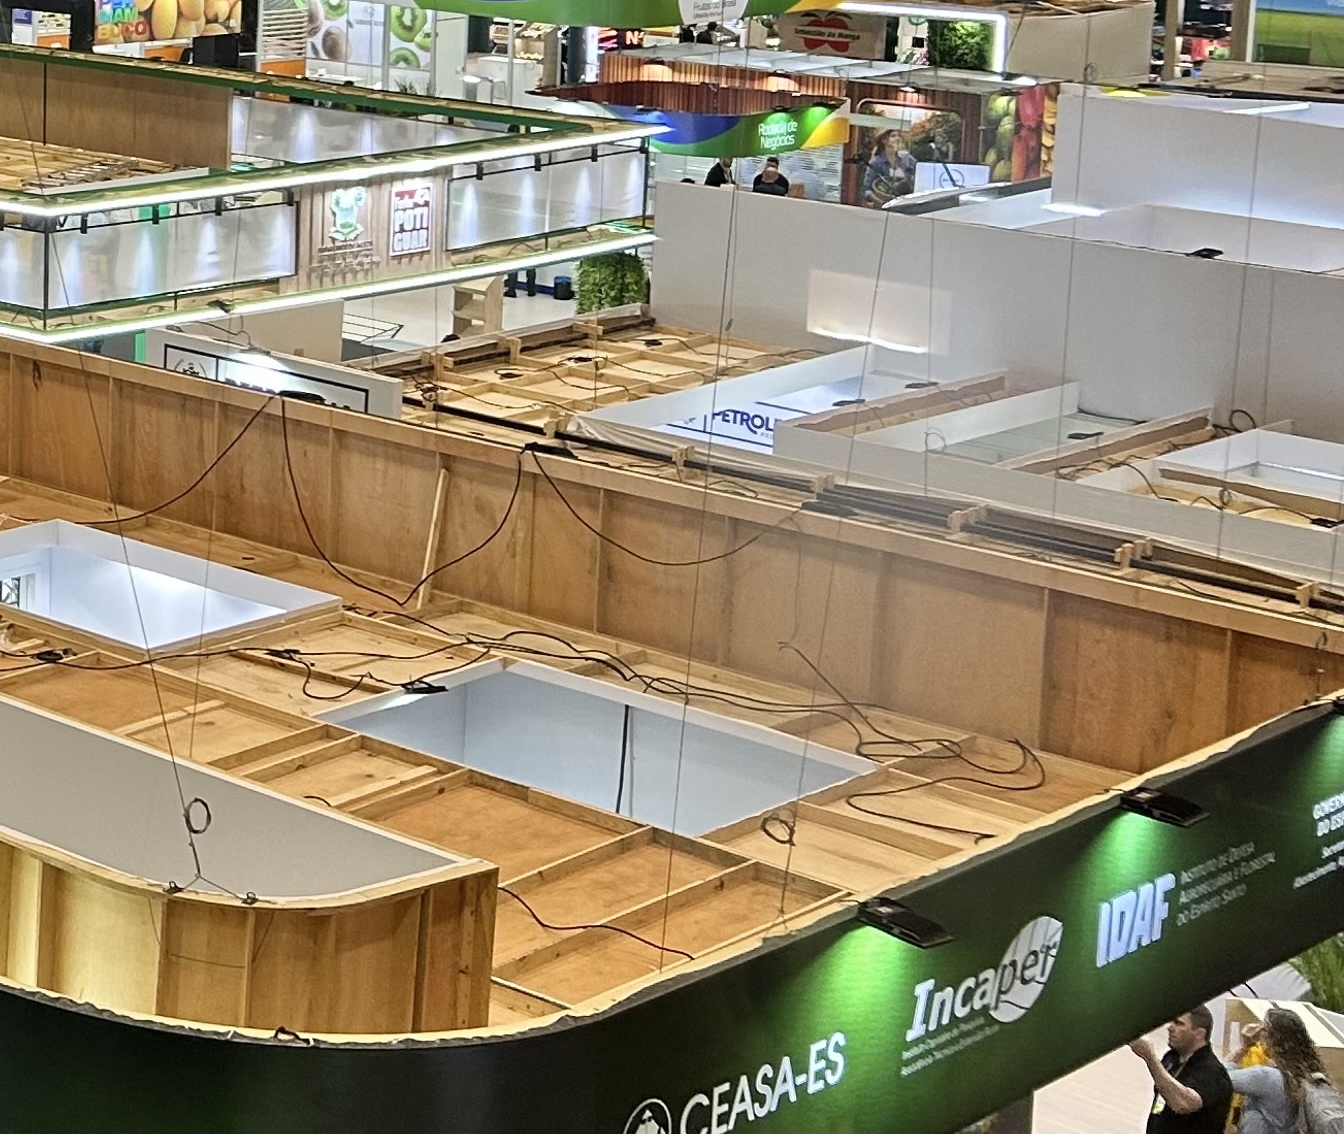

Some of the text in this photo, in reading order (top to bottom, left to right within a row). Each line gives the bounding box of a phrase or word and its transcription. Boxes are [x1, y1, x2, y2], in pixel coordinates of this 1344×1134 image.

[1096, 872, 1177, 968] IDAF
[905, 940, 1060, 1043] Incaper
[679, 1031, 846, 1134] CEASA-ES
